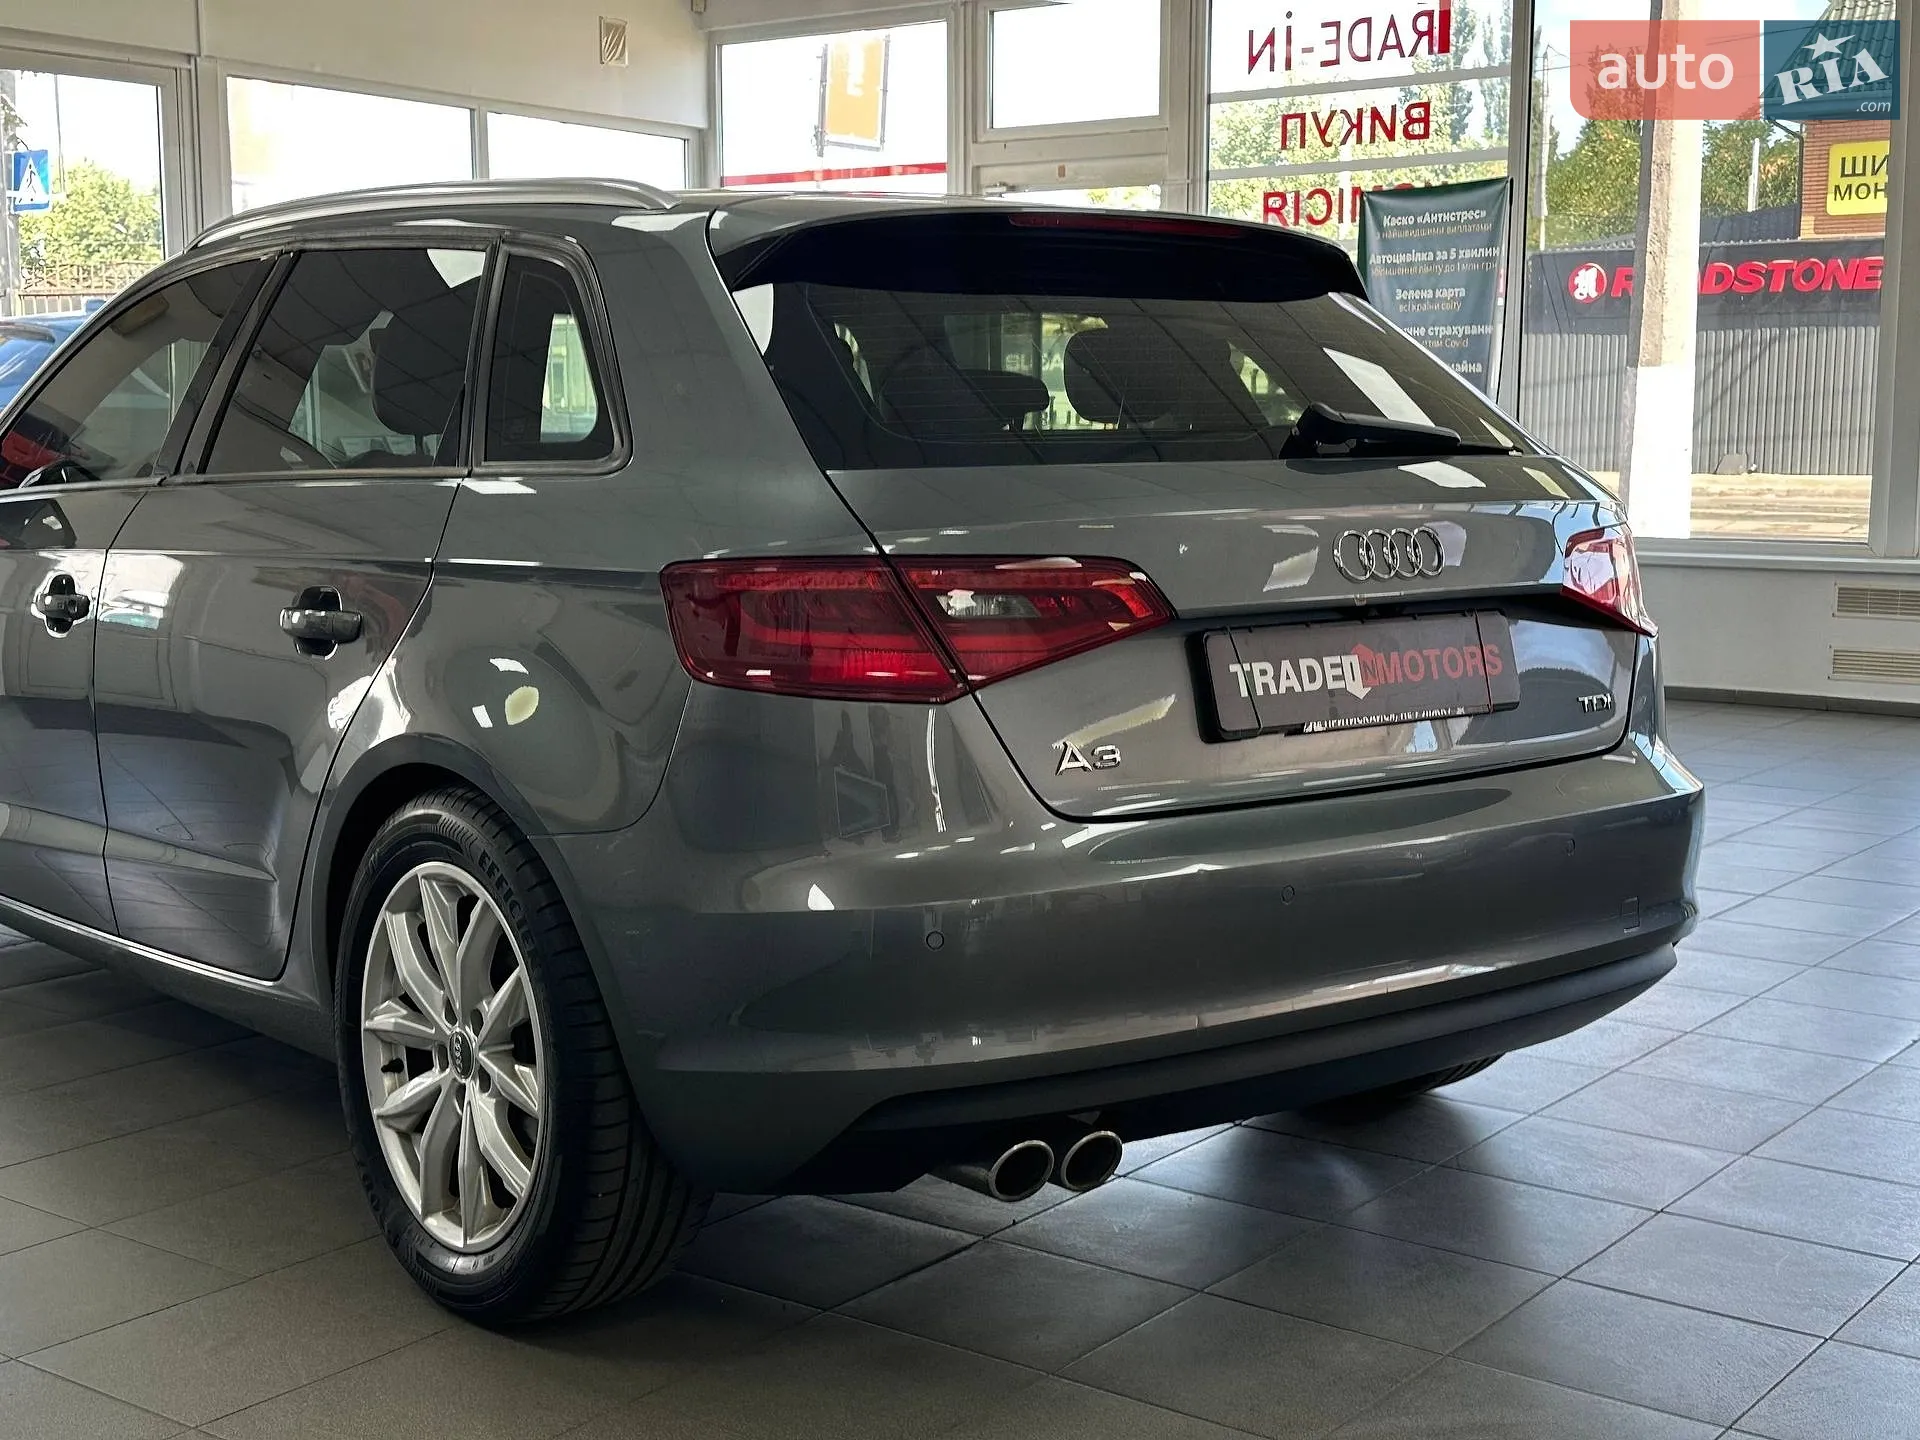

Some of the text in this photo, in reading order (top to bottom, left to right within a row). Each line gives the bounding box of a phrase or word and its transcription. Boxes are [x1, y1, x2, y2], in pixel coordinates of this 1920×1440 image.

[1382, 214, 1415, 228] Каско
[1369, 249, 1434, 265] Автоцивілка
[1436, 249, 1448, 261] за
[1449, 247, 1457, 259] 5
[1610, 256, 1885, 298] RDSTONE
[1395, 287, 1466, 301] Зелена карта
[1576, 692, 1615, 714] TDI
[1054, 739, 1122, 777] A3
